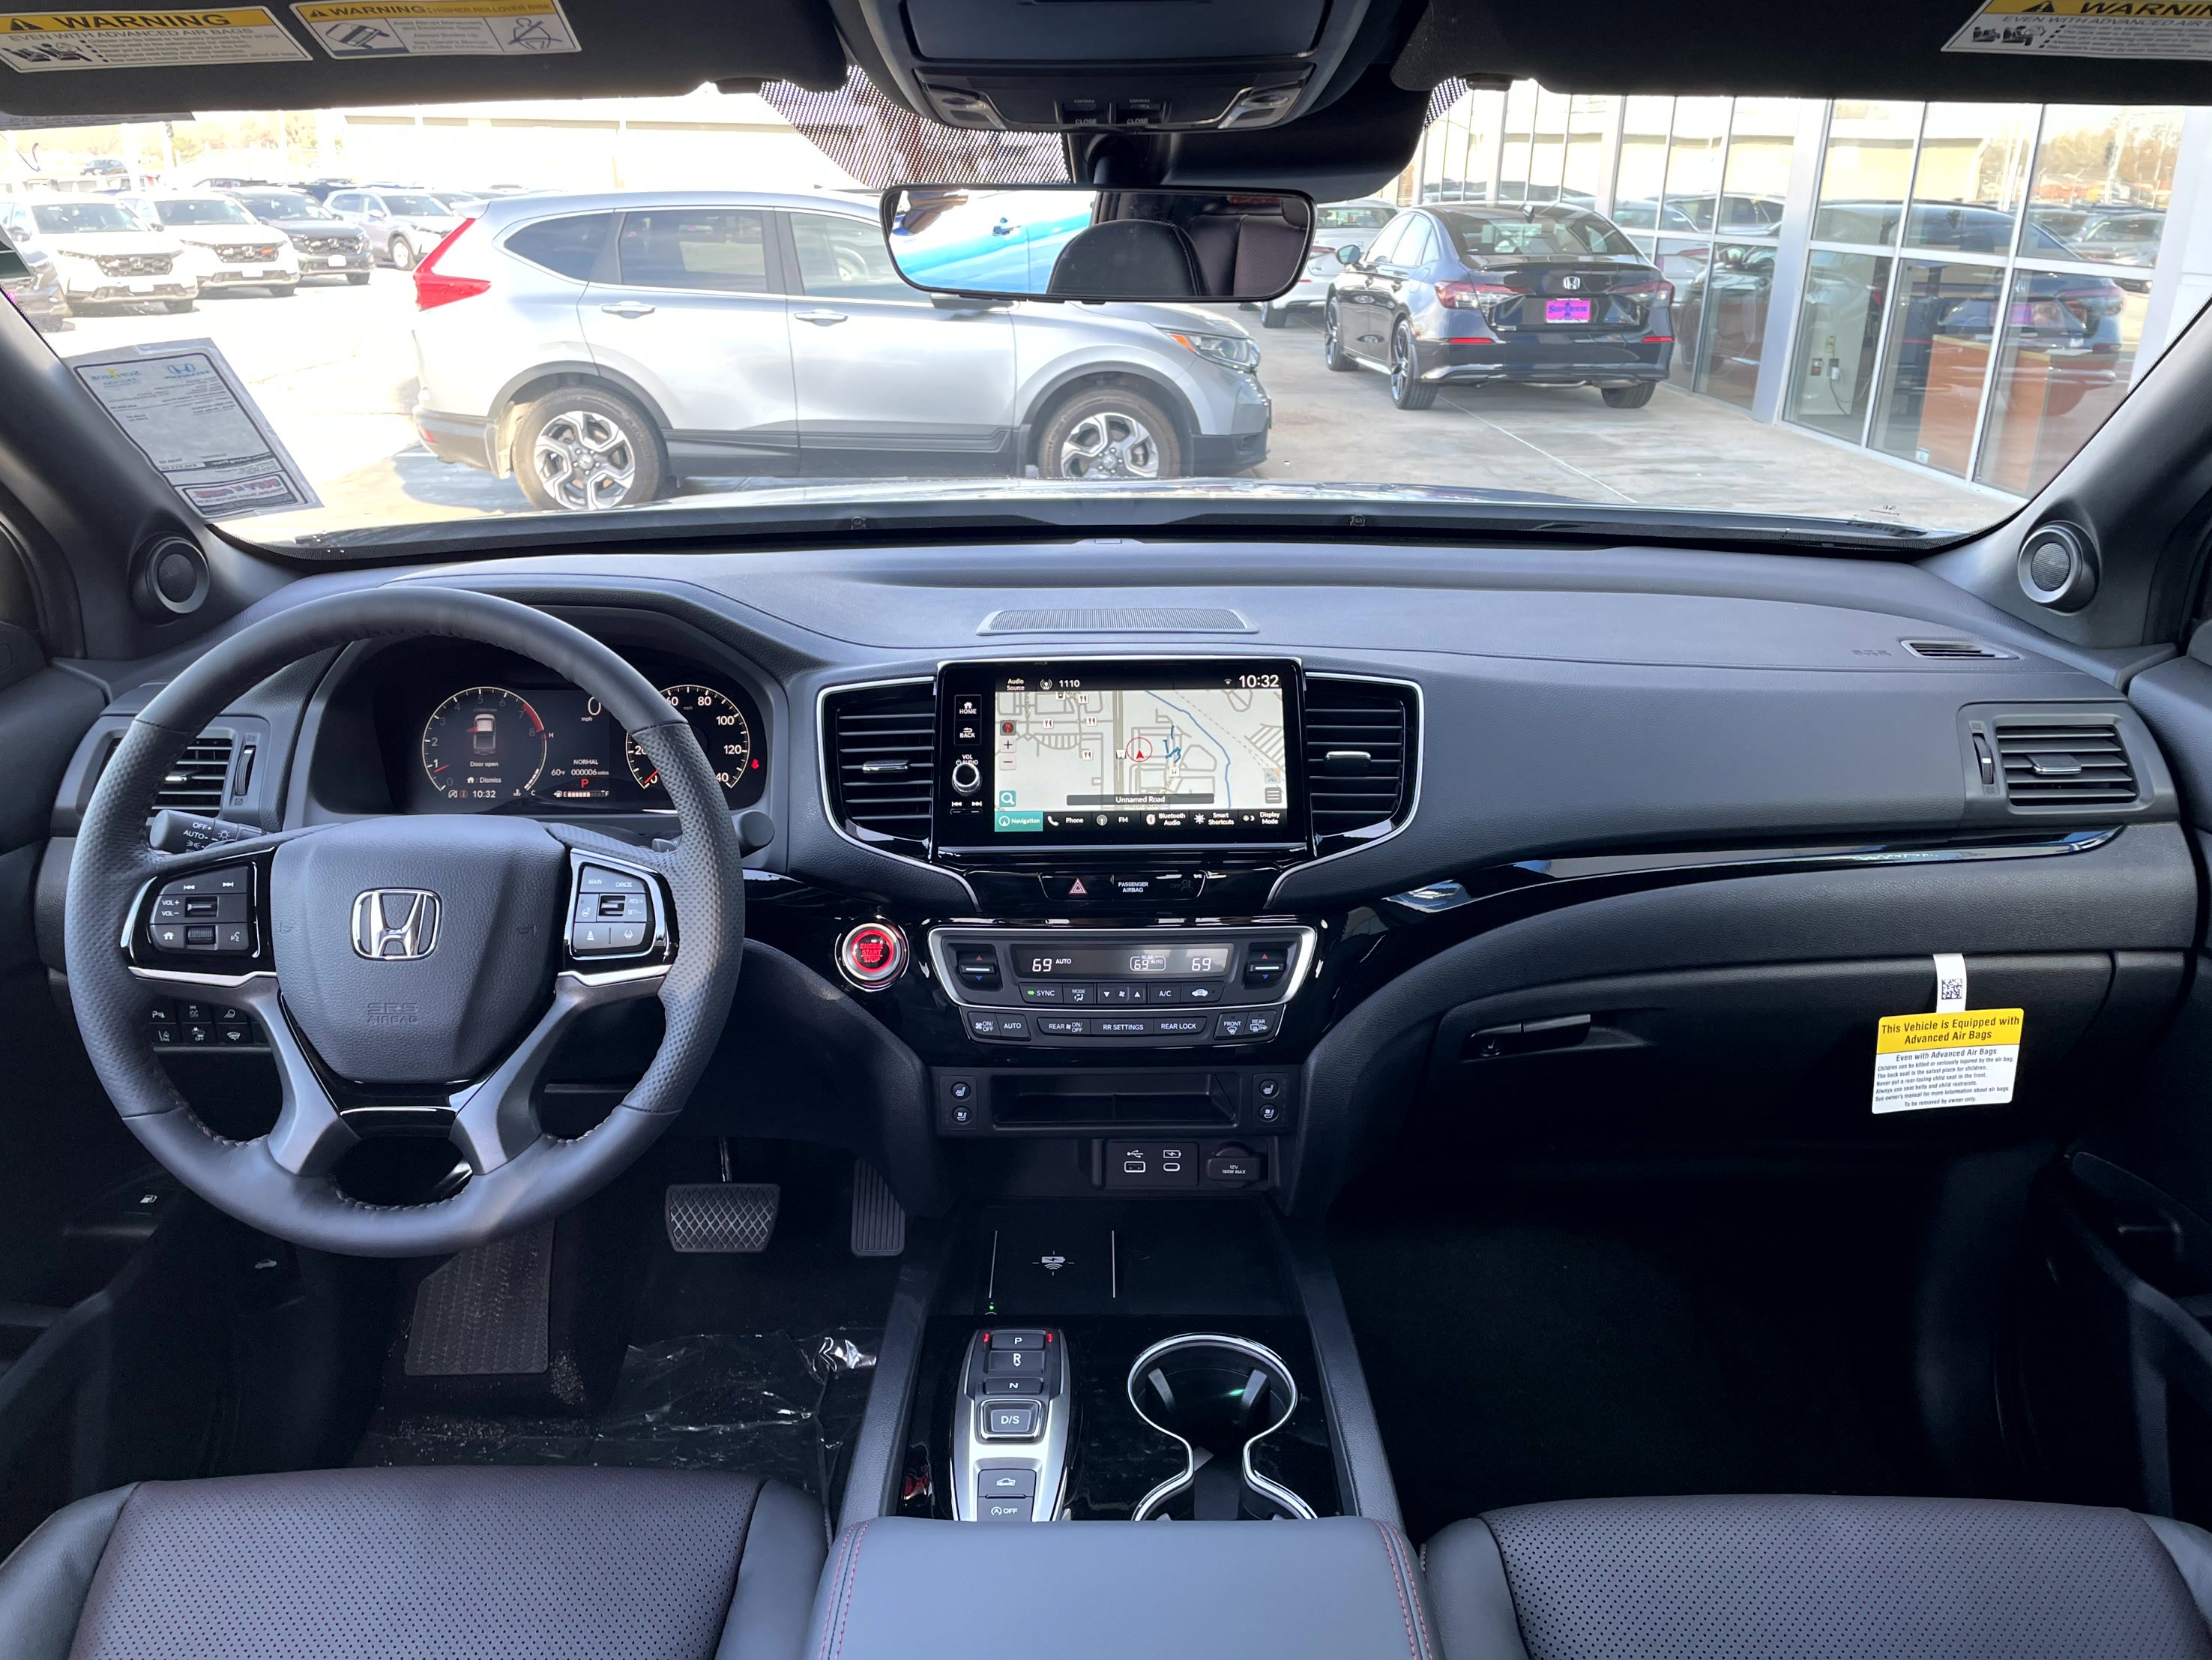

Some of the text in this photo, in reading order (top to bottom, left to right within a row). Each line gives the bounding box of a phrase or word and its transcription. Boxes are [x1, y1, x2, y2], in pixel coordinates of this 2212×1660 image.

[330, 6, 430, 16] WARNING:
[52, 14, 230, 28] WARNING
[1059, 679, 1080, 688] 1110
[1238, 675, 1280, 688] 10:32
[588, 697, 601, 716] 0
[697, 697, 711, 706] 80
[716, 716, 735, 726] 100
[431, 737, 439, 747] 2
[723, 745, 742, 754] 120
[433, 759, 439, 768] 1
[581, 778, 589, 789] P
[472, 790, 496, 799] 10:32
[193, 822, 208, 831] OFF
[1011, 817, 1040, 826] Navigation
[183, 830, 205, 839] AUTO
[1032, 958, 1052, 972] 69
[1133, 960, 1149, 969] 69
[1192, 958, 1211, 972] 69
[1881, 1016, 2019, 1034] This Vehicle is Equipped with
[1905, 1030, 1992, 1044] Advanced Air Bags
[1931, 1050, 1965, 1059] Advanced
[1979, 1048, 1998, 1056] Bags
[1013, 1353, 1022, 1364] R
[1001, 1416, 1020, 1425] D/S
